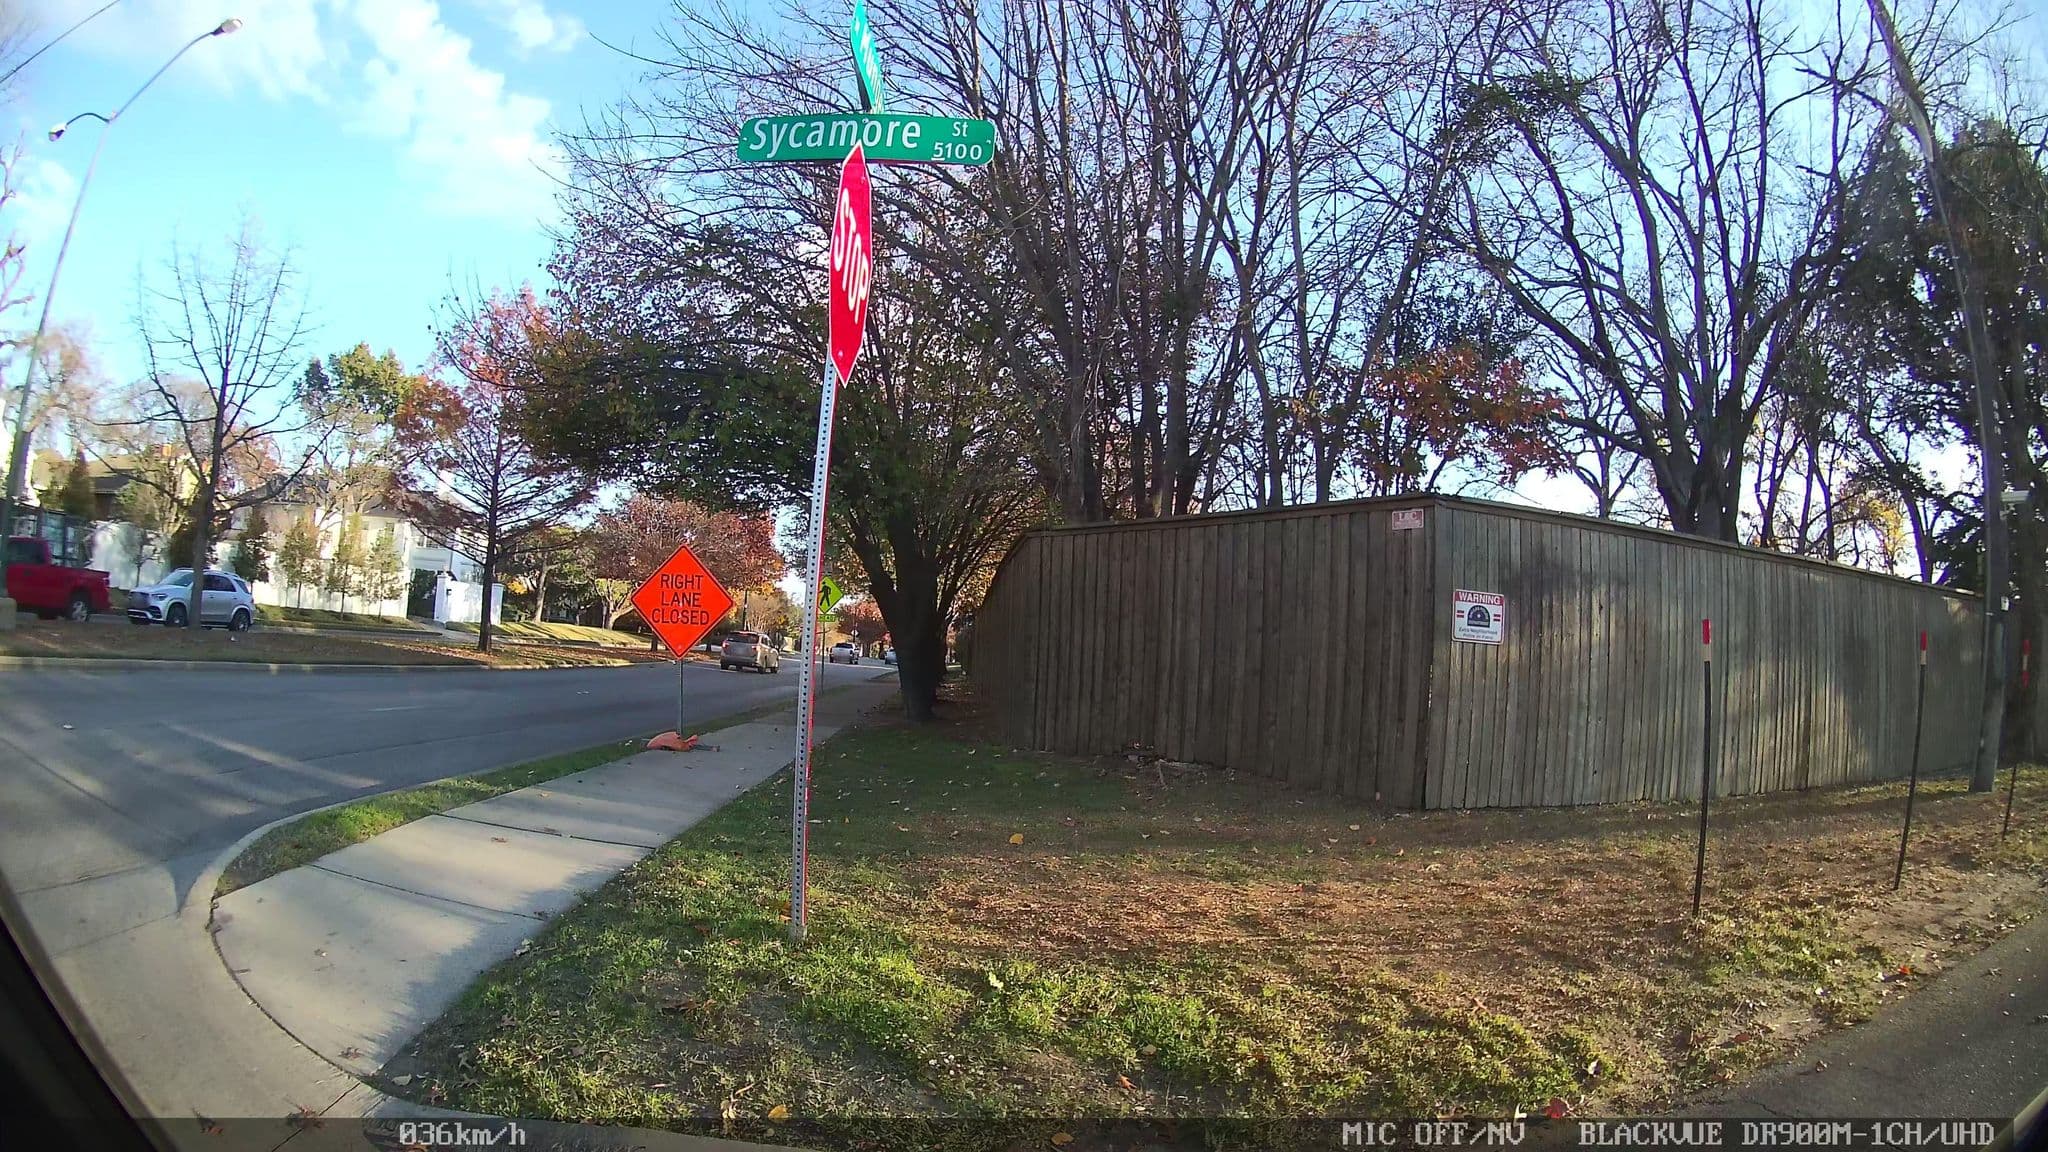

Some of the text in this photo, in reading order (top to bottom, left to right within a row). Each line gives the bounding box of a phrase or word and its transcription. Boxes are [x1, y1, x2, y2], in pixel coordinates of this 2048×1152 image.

[749, 117, 968, 158] Sycamore St
[930, 142, 982, 161] 5100
[833, 187, 869, 324] STOP
[660, 573, 704, 590] RIGHT
[661, 591, 702, 608] LANE
[1458, 591, 1501, 605] WARNING
[651, 608, 710, 626] CLOSED
